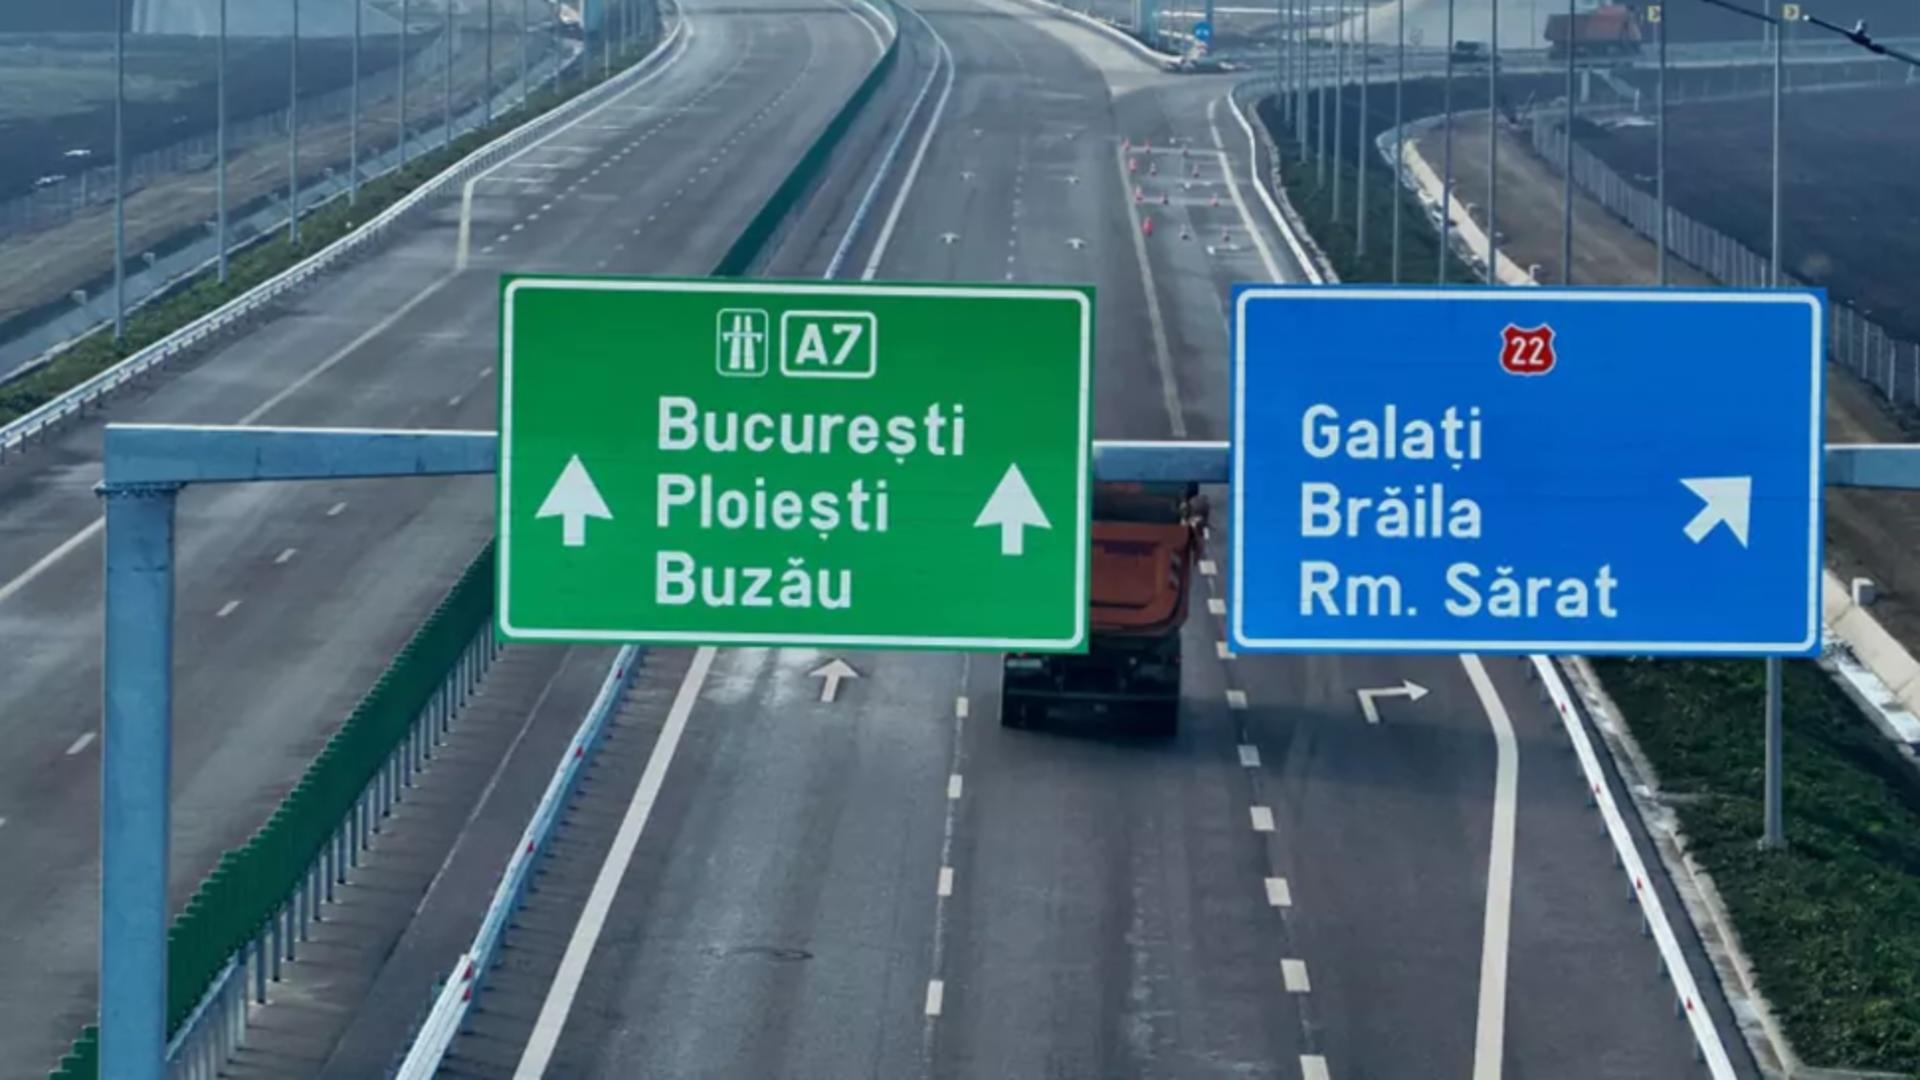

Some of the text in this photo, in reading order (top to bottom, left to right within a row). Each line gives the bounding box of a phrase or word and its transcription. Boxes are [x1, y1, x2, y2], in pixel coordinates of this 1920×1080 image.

[795, 323, 863, 365] A7
[1510, 337, 1545, 365] 22
[658, 396, 965, 463] București
[1302, 404, 1481, 469] Galați
[656, 474, 888, 539] Ploiești
[1301, 483, 1481, 538] Brăila
[655, 551, 852, 609] Buzău
[1300, 561, 1618, 618] Rm. Sărat
